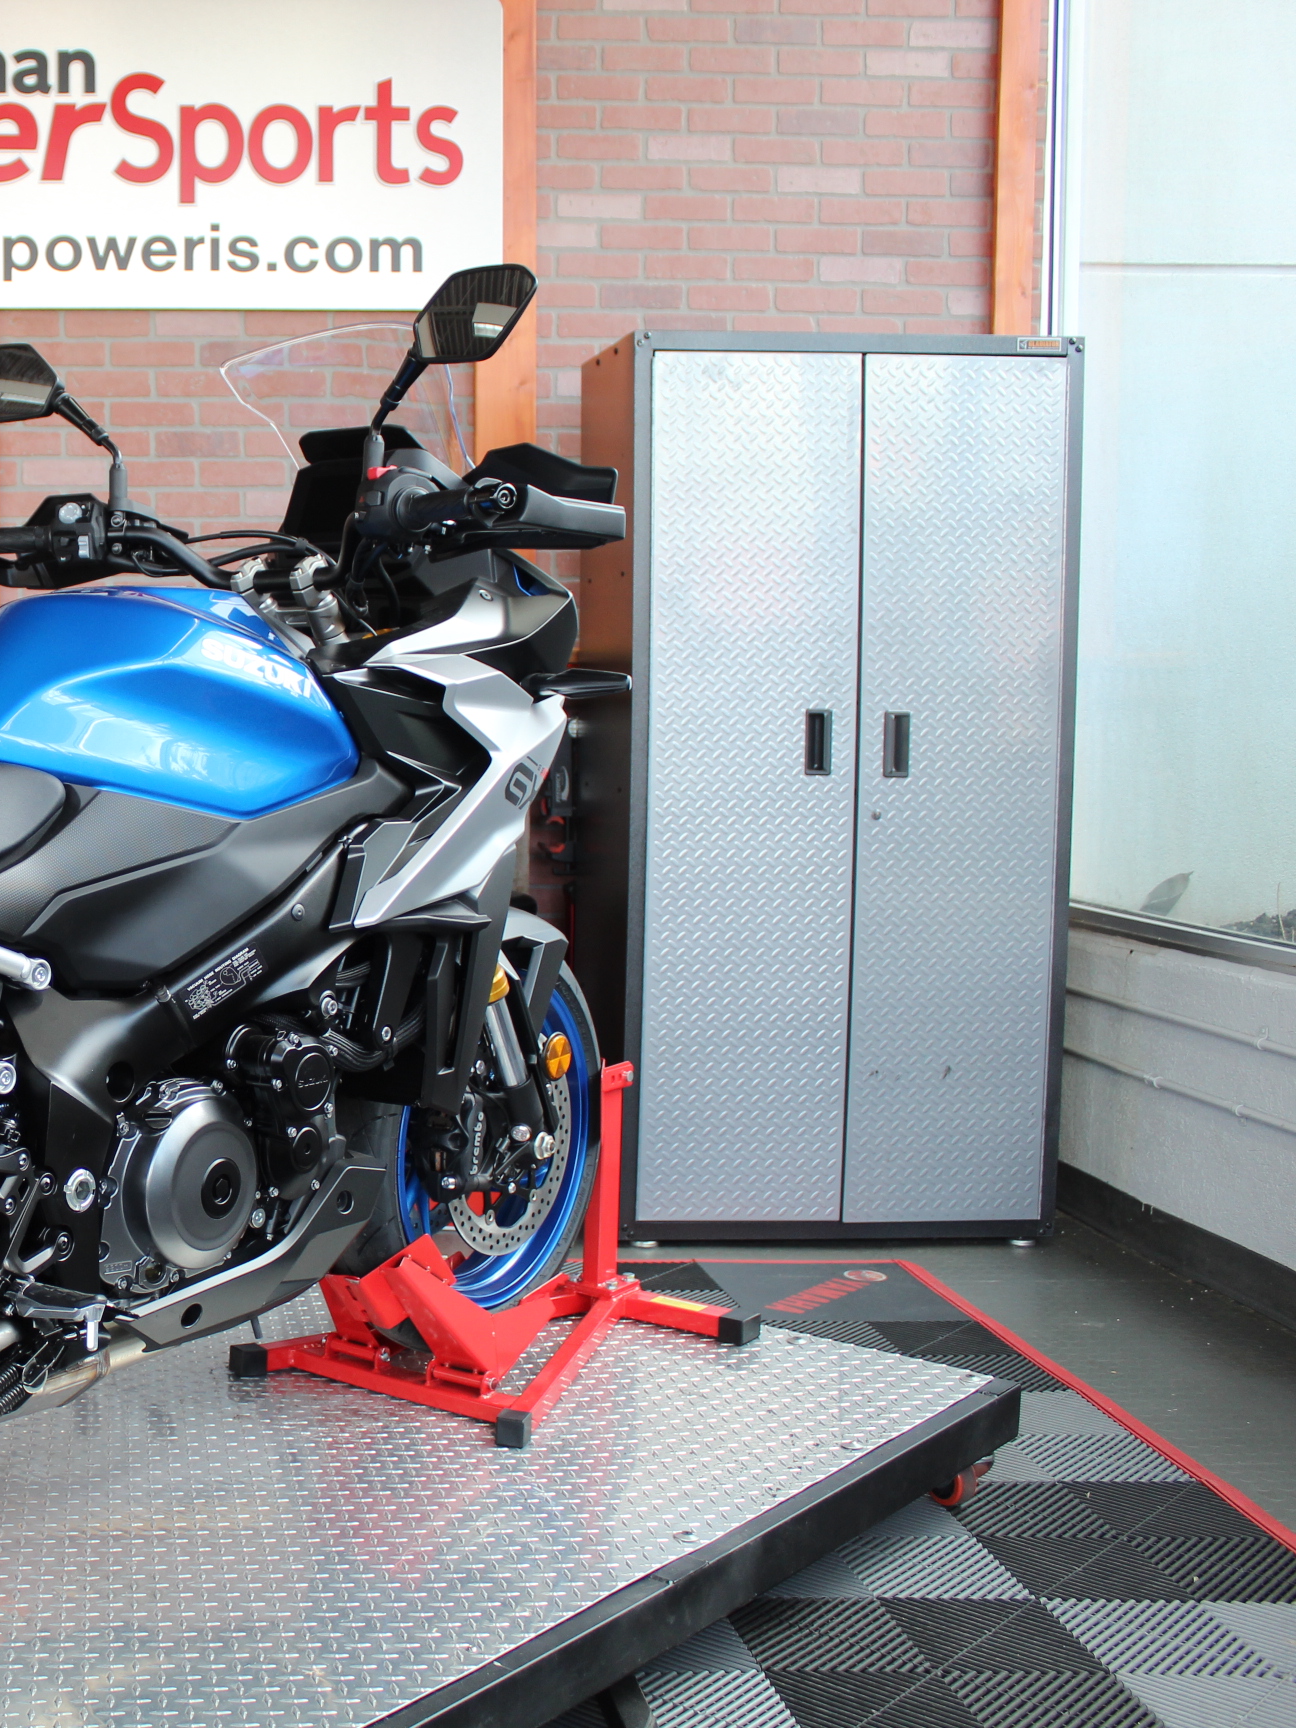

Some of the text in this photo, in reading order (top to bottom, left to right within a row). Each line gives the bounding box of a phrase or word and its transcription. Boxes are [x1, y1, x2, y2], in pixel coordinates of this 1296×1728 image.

[200, 637, 312, 699] SUZUKI
[469, 1111, 485, 1175] brembo
[763, 1277, 871, 1315] YAMAHA
